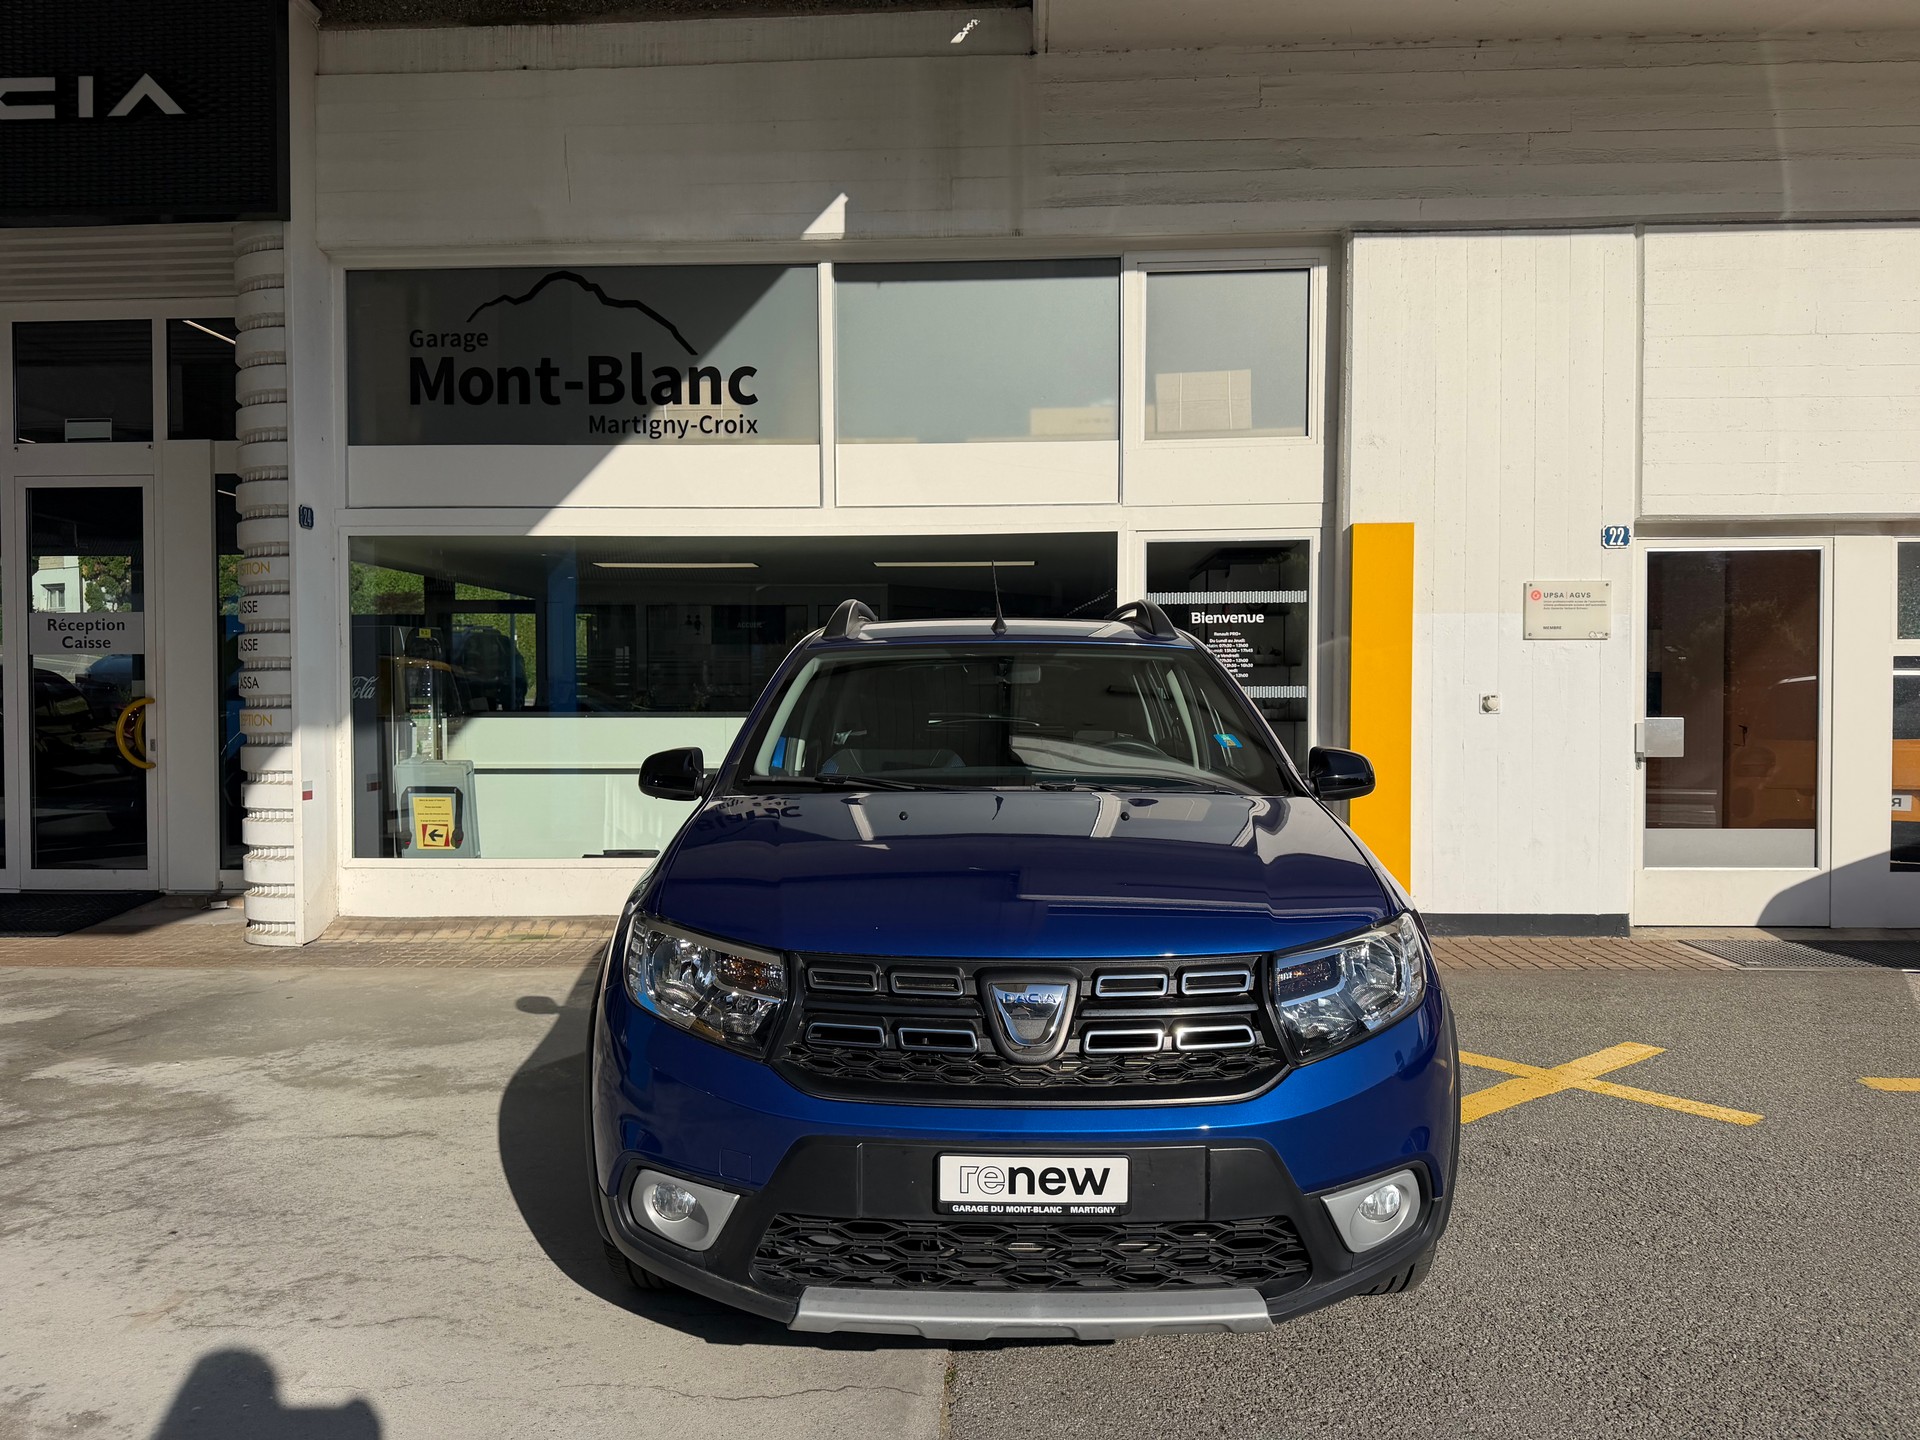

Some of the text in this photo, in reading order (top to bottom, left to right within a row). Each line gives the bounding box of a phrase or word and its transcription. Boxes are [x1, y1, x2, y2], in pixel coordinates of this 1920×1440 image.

[408, 329, 489, 351] Garage
[409, 352, 759, 406] Mont-Blanc
[588, 414, 759, 439] Martigny-Croix
[303, 508, 312, 527] 24
[1609, 527, 1625, 546] 22
[47, 617, 126, 635] Réception
[1191, 612, 1264, 624] Bienvenue
[61, 635, 111, 649] Caisse
[1003, 993, 1056, 1004] DACIA
[959, 1165, 1111, 1196] renew
[952, 1205, 1116, 1214] GARAGE DU MONT-BLANC MARTIGNY
